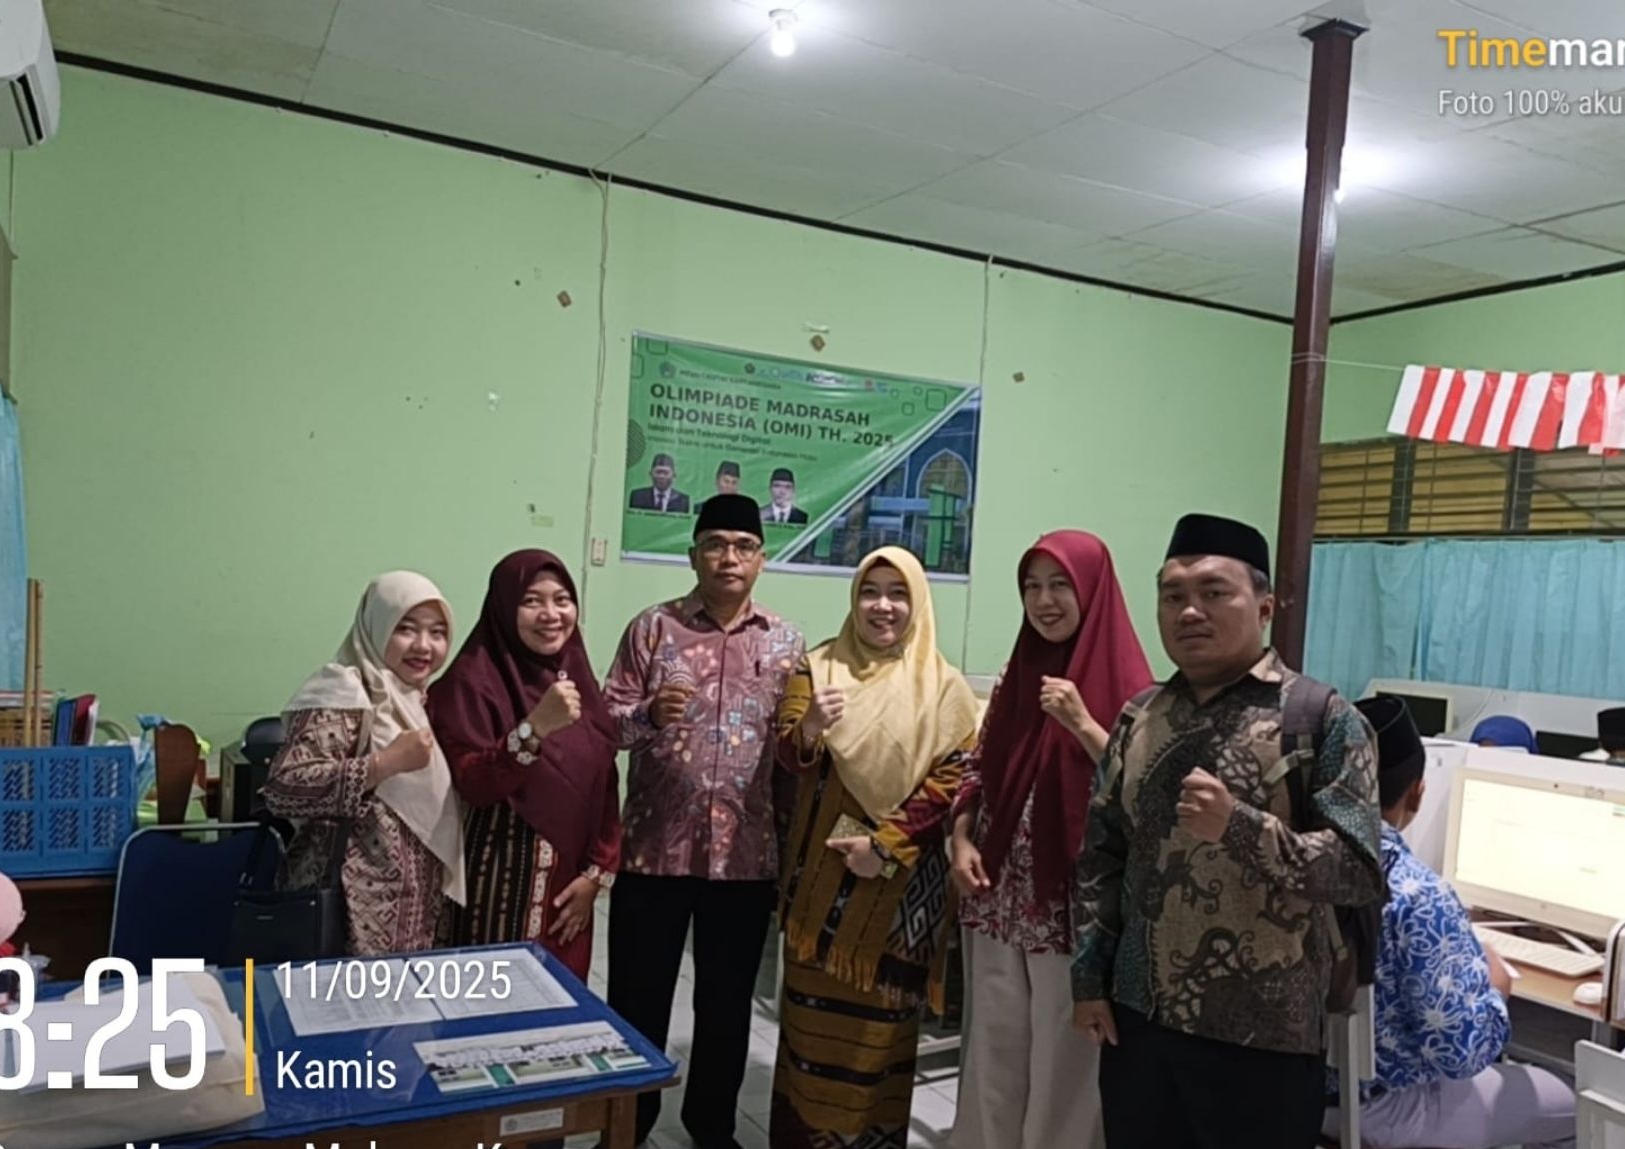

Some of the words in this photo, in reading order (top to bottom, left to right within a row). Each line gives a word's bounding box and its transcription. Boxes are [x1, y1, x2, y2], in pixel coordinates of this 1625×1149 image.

[649, 403, 757, 431] INDONESIA
[763, 419, 812, 440] (OMI)
[818, 425, 847, 443] TH.
[852, 431, 894, 448] 2025
[650, 383, 760, 412] OLIMPIADE
[766, 400, 870, 427] MADRASAH
